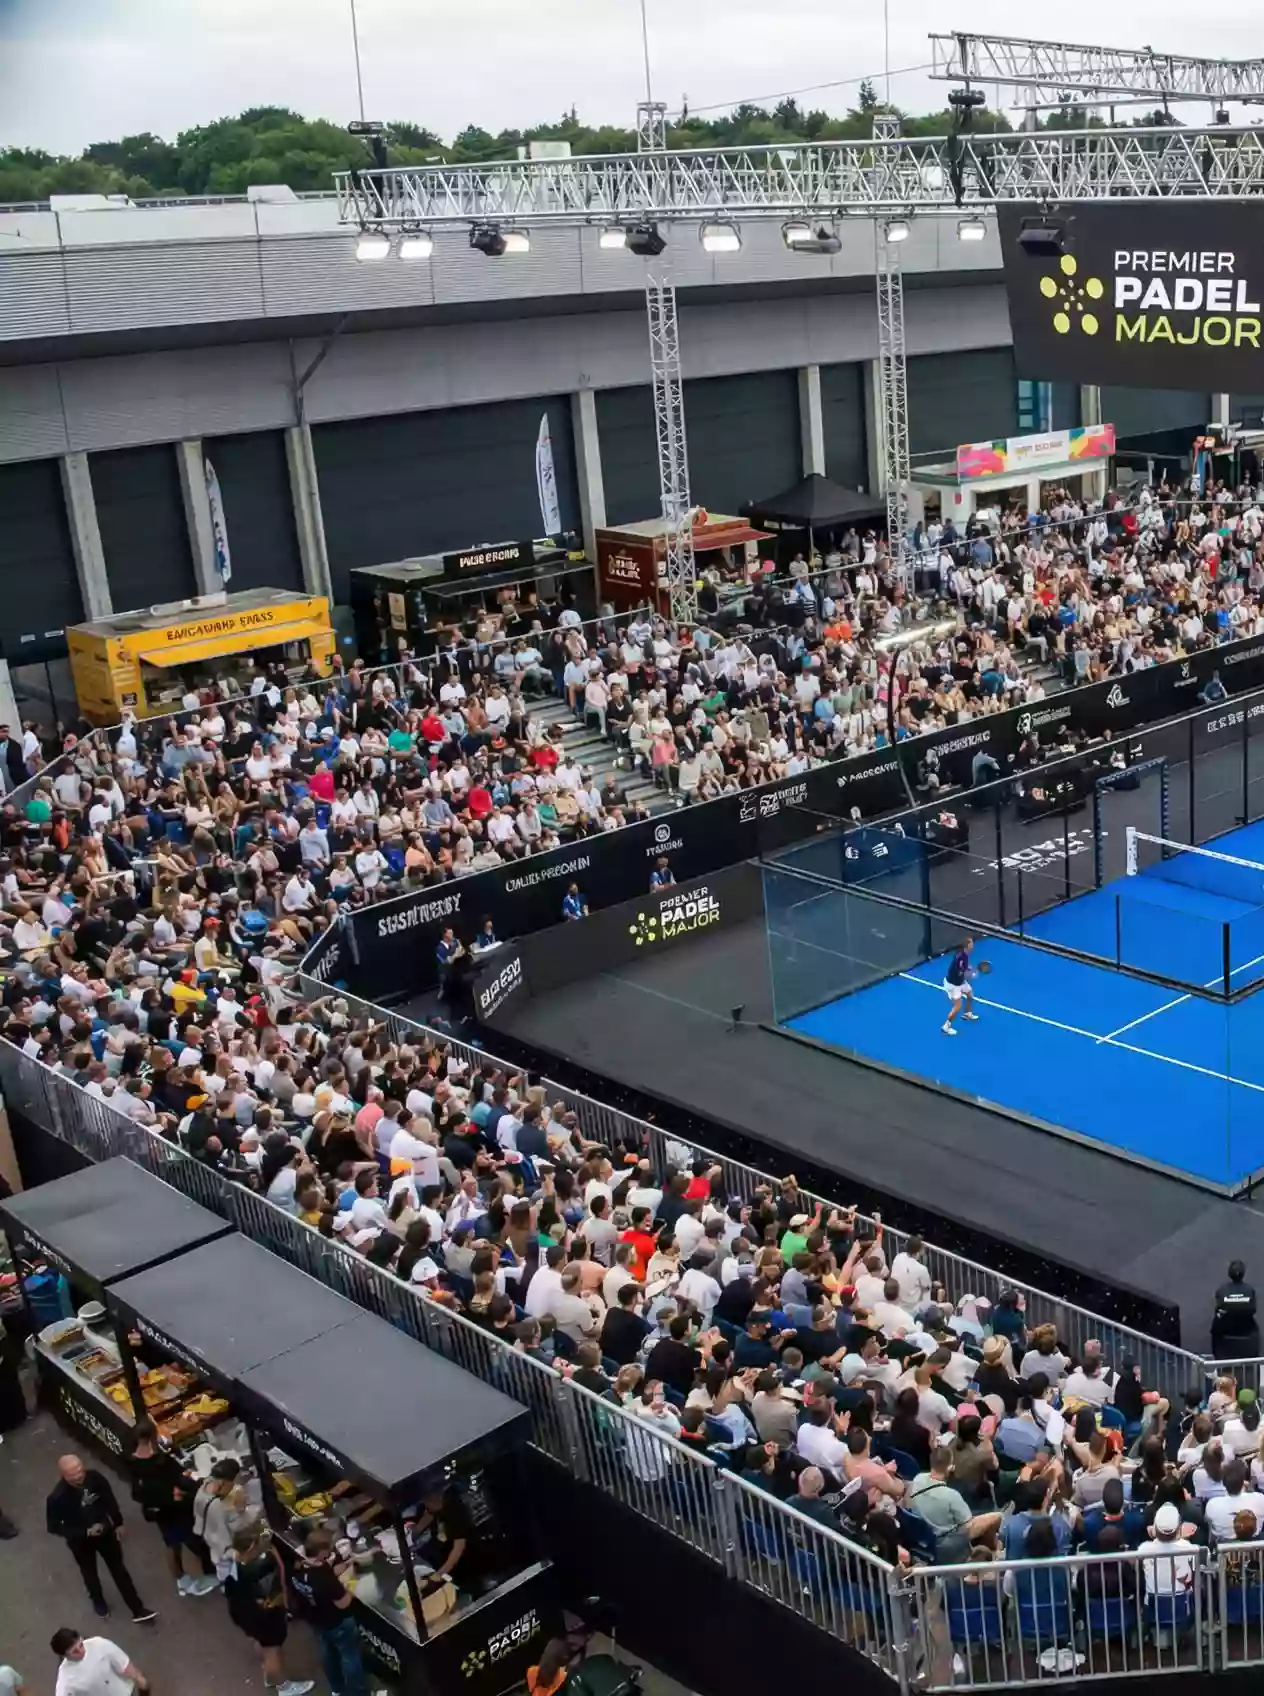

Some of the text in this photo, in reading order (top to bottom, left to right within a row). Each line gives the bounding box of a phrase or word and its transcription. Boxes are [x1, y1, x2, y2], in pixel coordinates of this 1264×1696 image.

[1114, 250, 1235, 273] PREMIER
[1114, 276, 1261, 313] PADEL
[1115, 314, 1262, 348] MAJOR
[661, 896, 720, 926] PADEL
[662, 909, 720, 941] MAJOR
